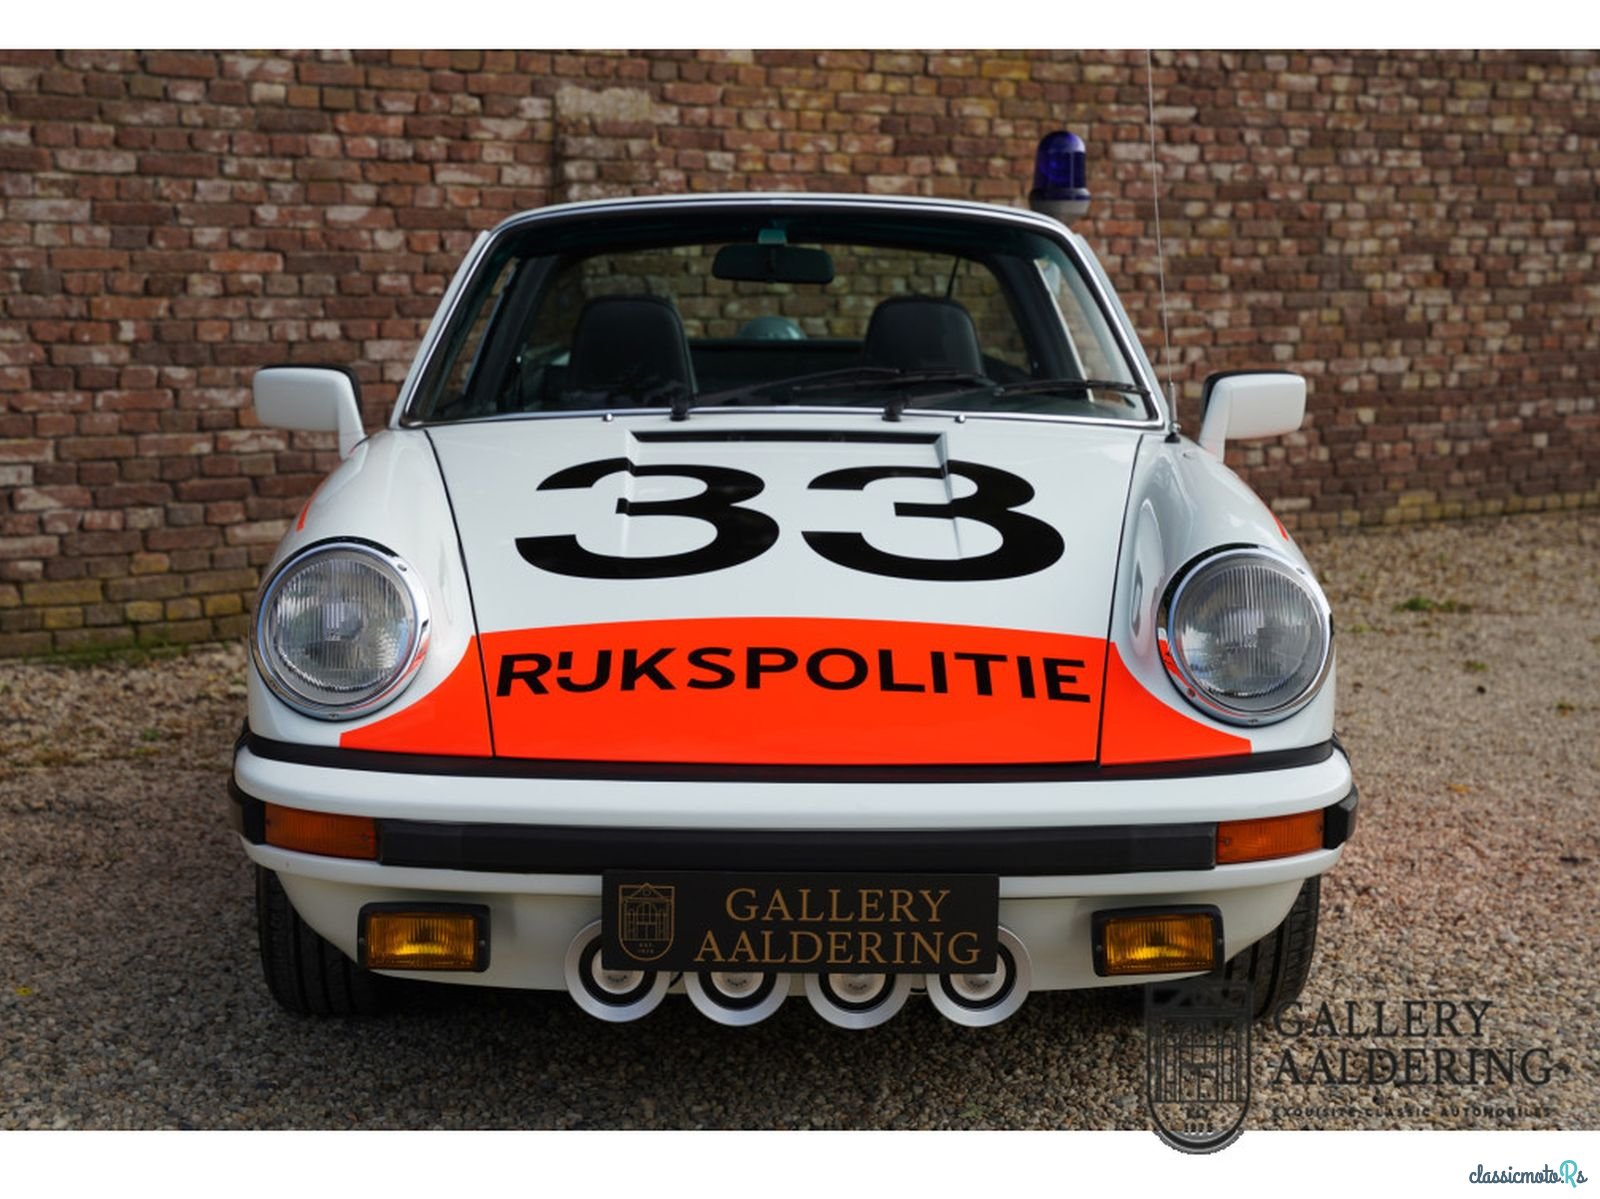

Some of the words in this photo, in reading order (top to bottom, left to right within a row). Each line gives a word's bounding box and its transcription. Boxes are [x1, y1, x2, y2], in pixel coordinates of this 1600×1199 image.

[514, 457, 1066, 582] 33
[725, 888, 951, 922] GALLERY
[694, 931, 981, 964] AALDERING
